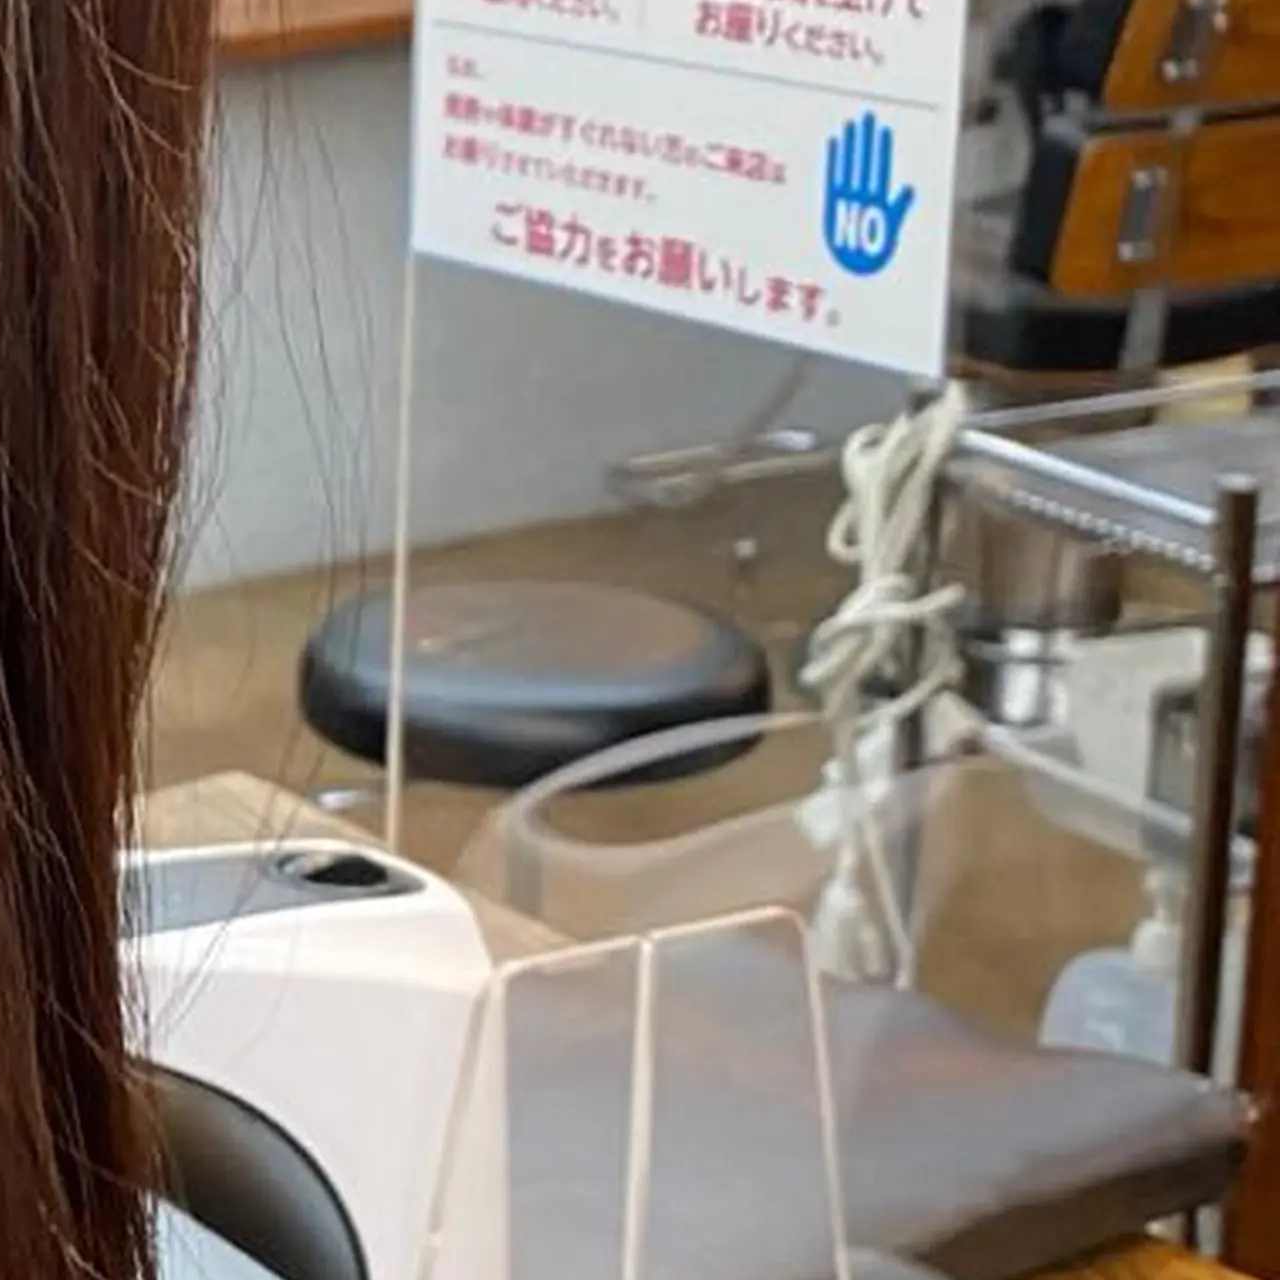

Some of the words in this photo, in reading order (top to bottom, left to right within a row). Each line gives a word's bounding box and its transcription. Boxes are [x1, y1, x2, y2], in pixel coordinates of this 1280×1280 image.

[491, 199, 840, 326] ご協力をお願いします。
[834, 198, 886, 255] NO
